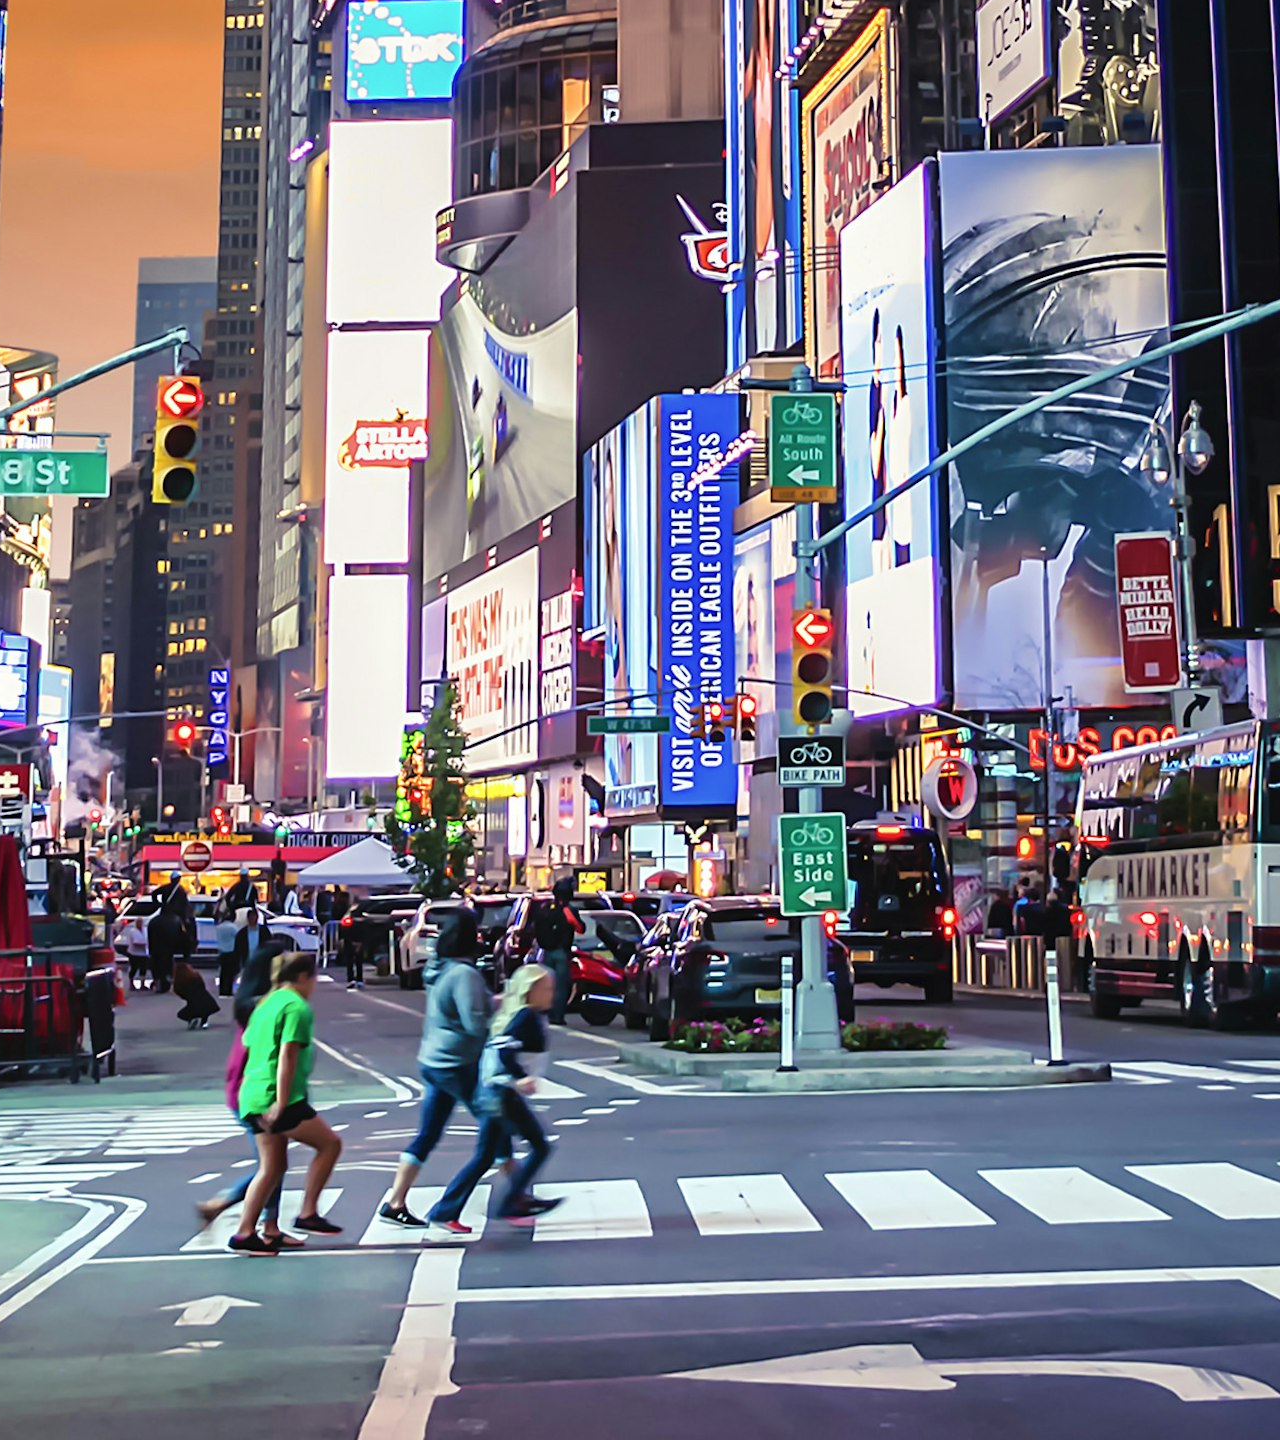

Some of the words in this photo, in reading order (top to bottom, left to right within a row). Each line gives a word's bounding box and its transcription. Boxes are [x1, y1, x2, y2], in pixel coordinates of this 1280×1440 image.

[669, 408, 693, 471] LEVEL
[783, 448, 823, 461] South
[35, 460, 71, 486] St
[671, 508, 693, 547] THE
[671, 553, 693, 583] ON
[698, 561, 722, 624] EAGLE
[1122, 576, 1169, 591] BETTE
[671, 590, 694, 658] INSIDE
[1126, 616, 1173, 637] DOLLY!
[698, 629, 723, 733] ERICAN
[622, 719, 636, 731] 47
[671, 737, 695, 792] VISIT
[783, 769, 808, 781] BIKE
[813, 769, 840, 781] PATH
[287, 834, 327, 847] MIGHTY
[793, 851, 833, 865] East
[794, 868, 833, 883] Side
[1117, 852, 1211, 900] HAYMARKET
